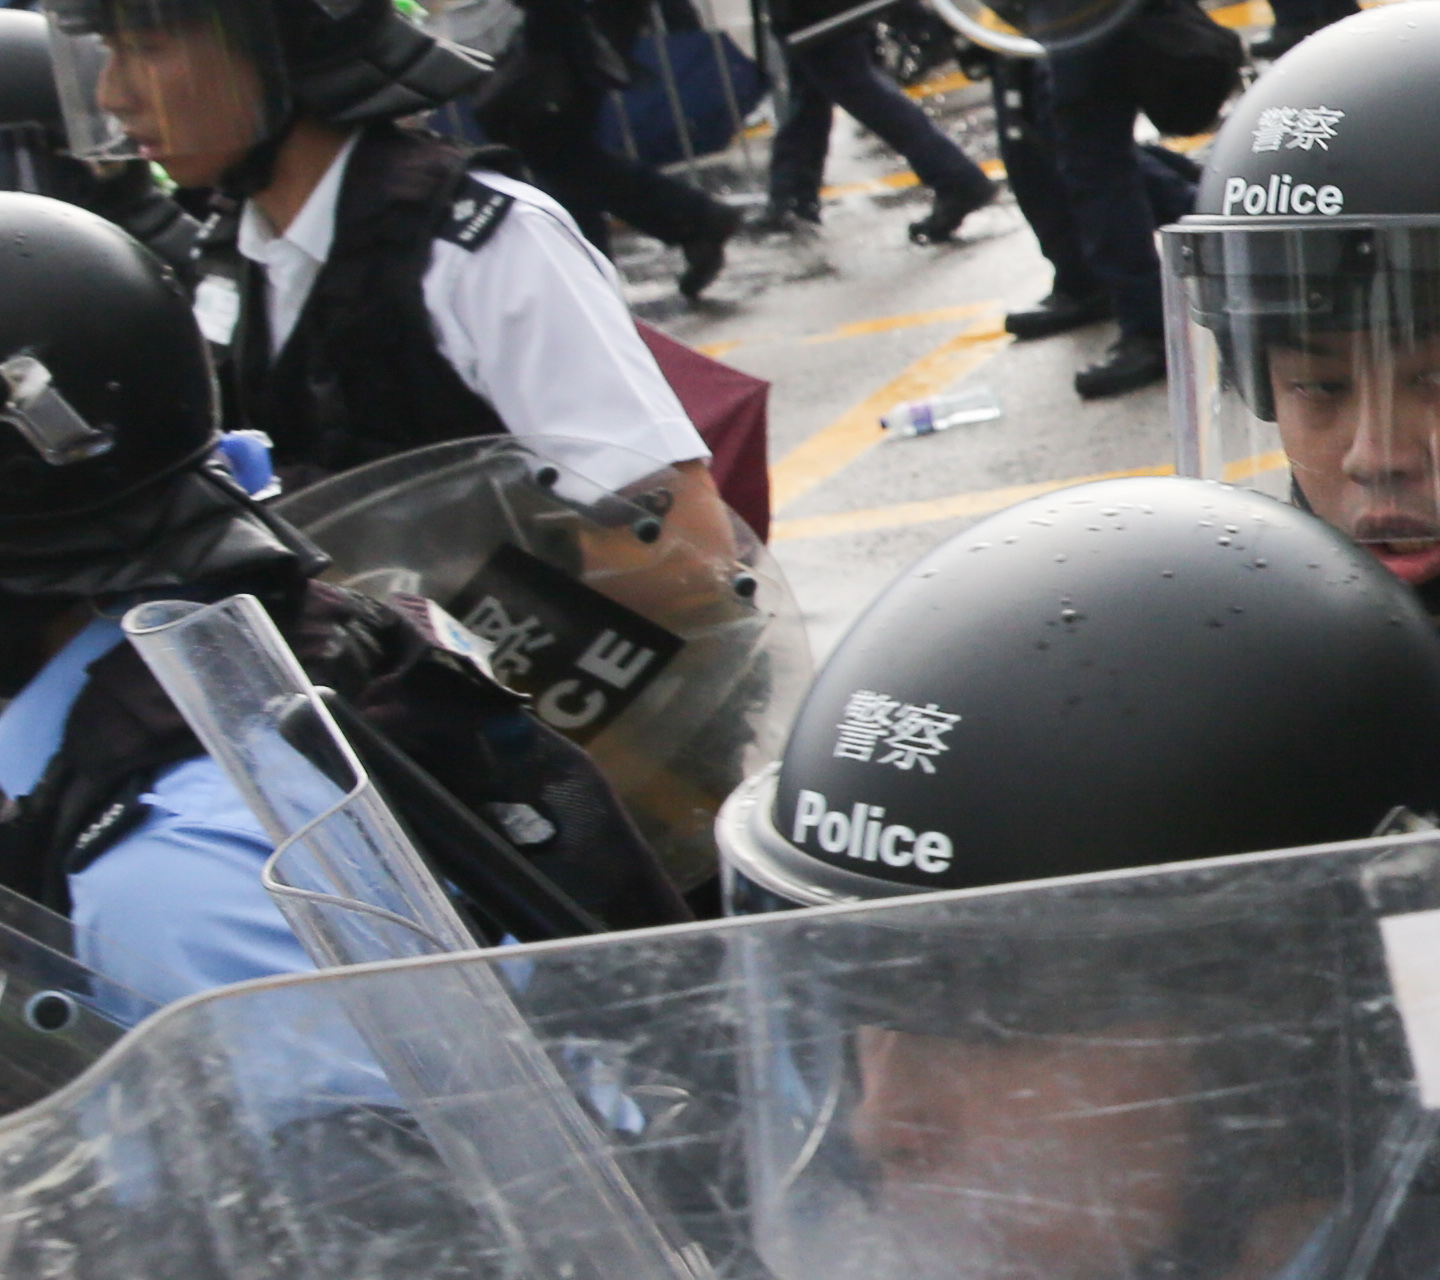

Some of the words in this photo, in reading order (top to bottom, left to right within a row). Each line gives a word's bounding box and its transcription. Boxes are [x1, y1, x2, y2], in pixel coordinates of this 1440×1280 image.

[1252, 106, 1345, 153] 警察
[1222, 174, 1345, 216] Police
[833, 689, 962, 773] 警察
[793, 790, 953, 874] Police
